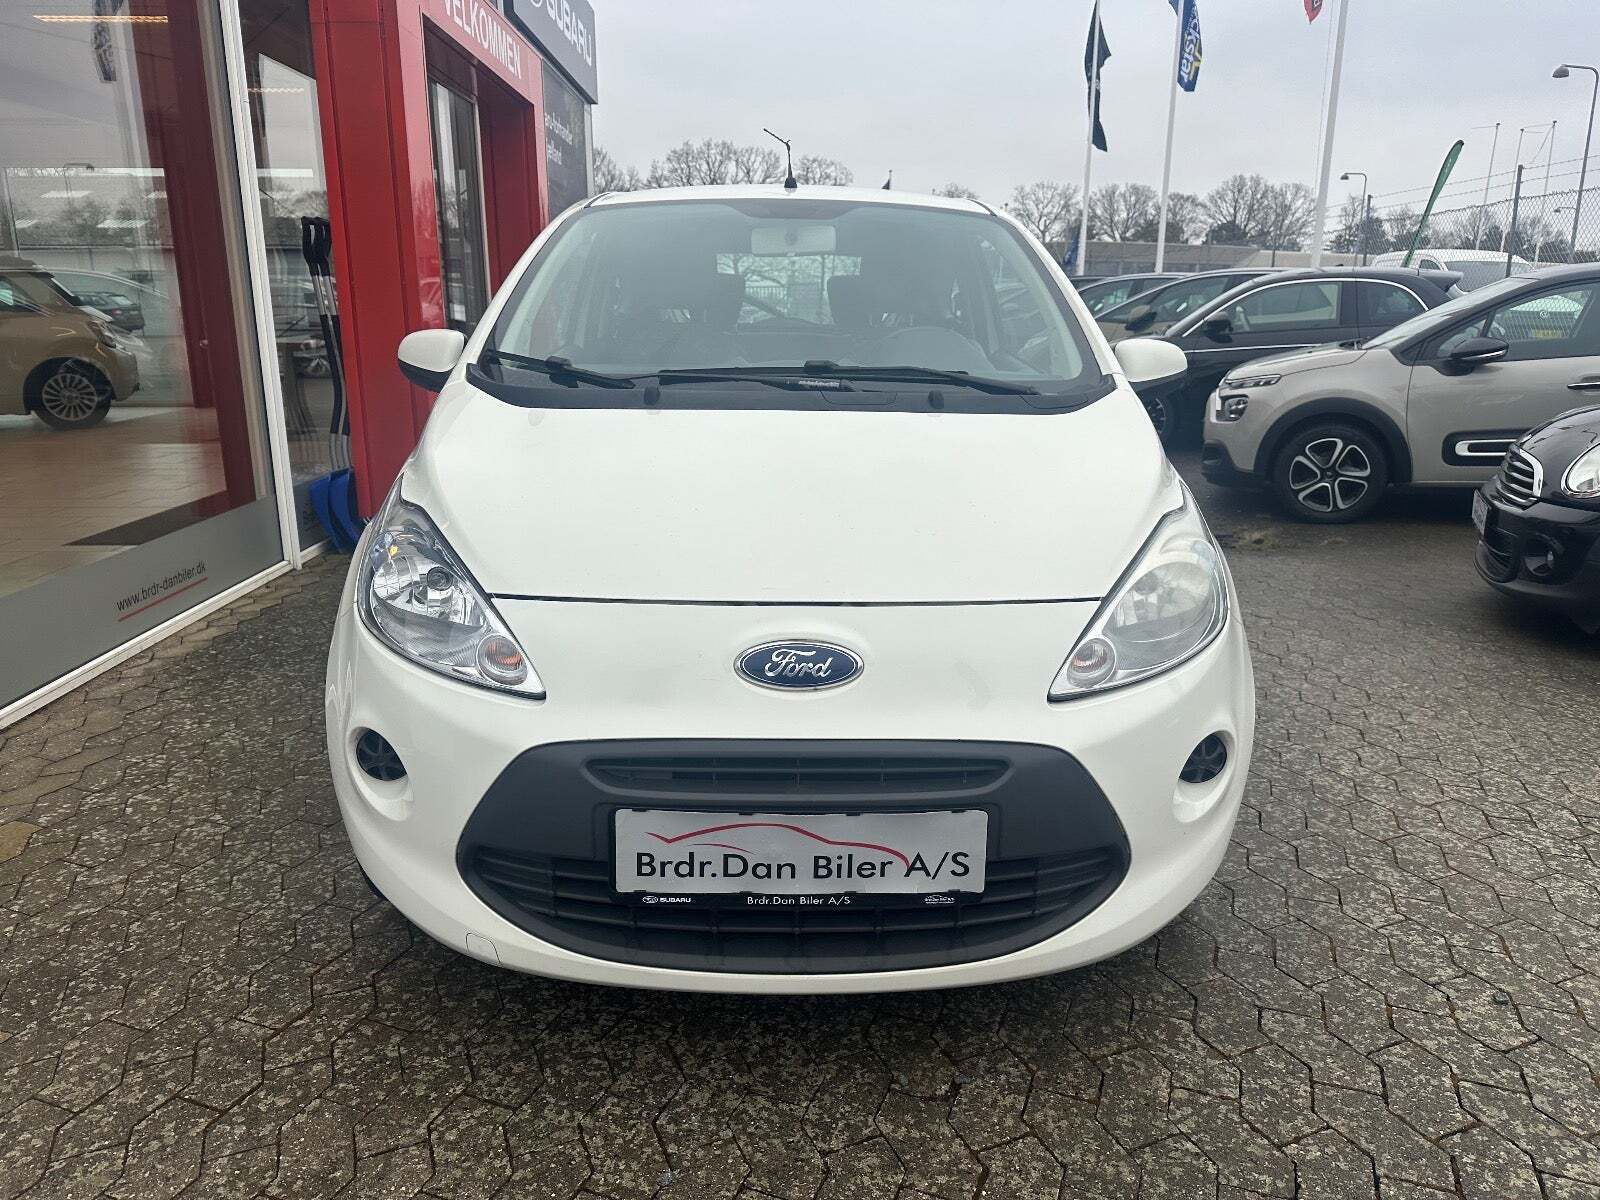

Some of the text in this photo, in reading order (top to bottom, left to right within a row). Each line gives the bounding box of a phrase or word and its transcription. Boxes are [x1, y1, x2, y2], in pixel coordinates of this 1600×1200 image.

[116, 560, 207, 612] www.brdr-danbiler.dk
[764, 648, 833, 678] Ford
[812, 854, 893, 880] Biler
[904, 851, 971, 880] A/S
[799, 896, 825, 906] Biler
[827, 896, 852, 907] A/S
